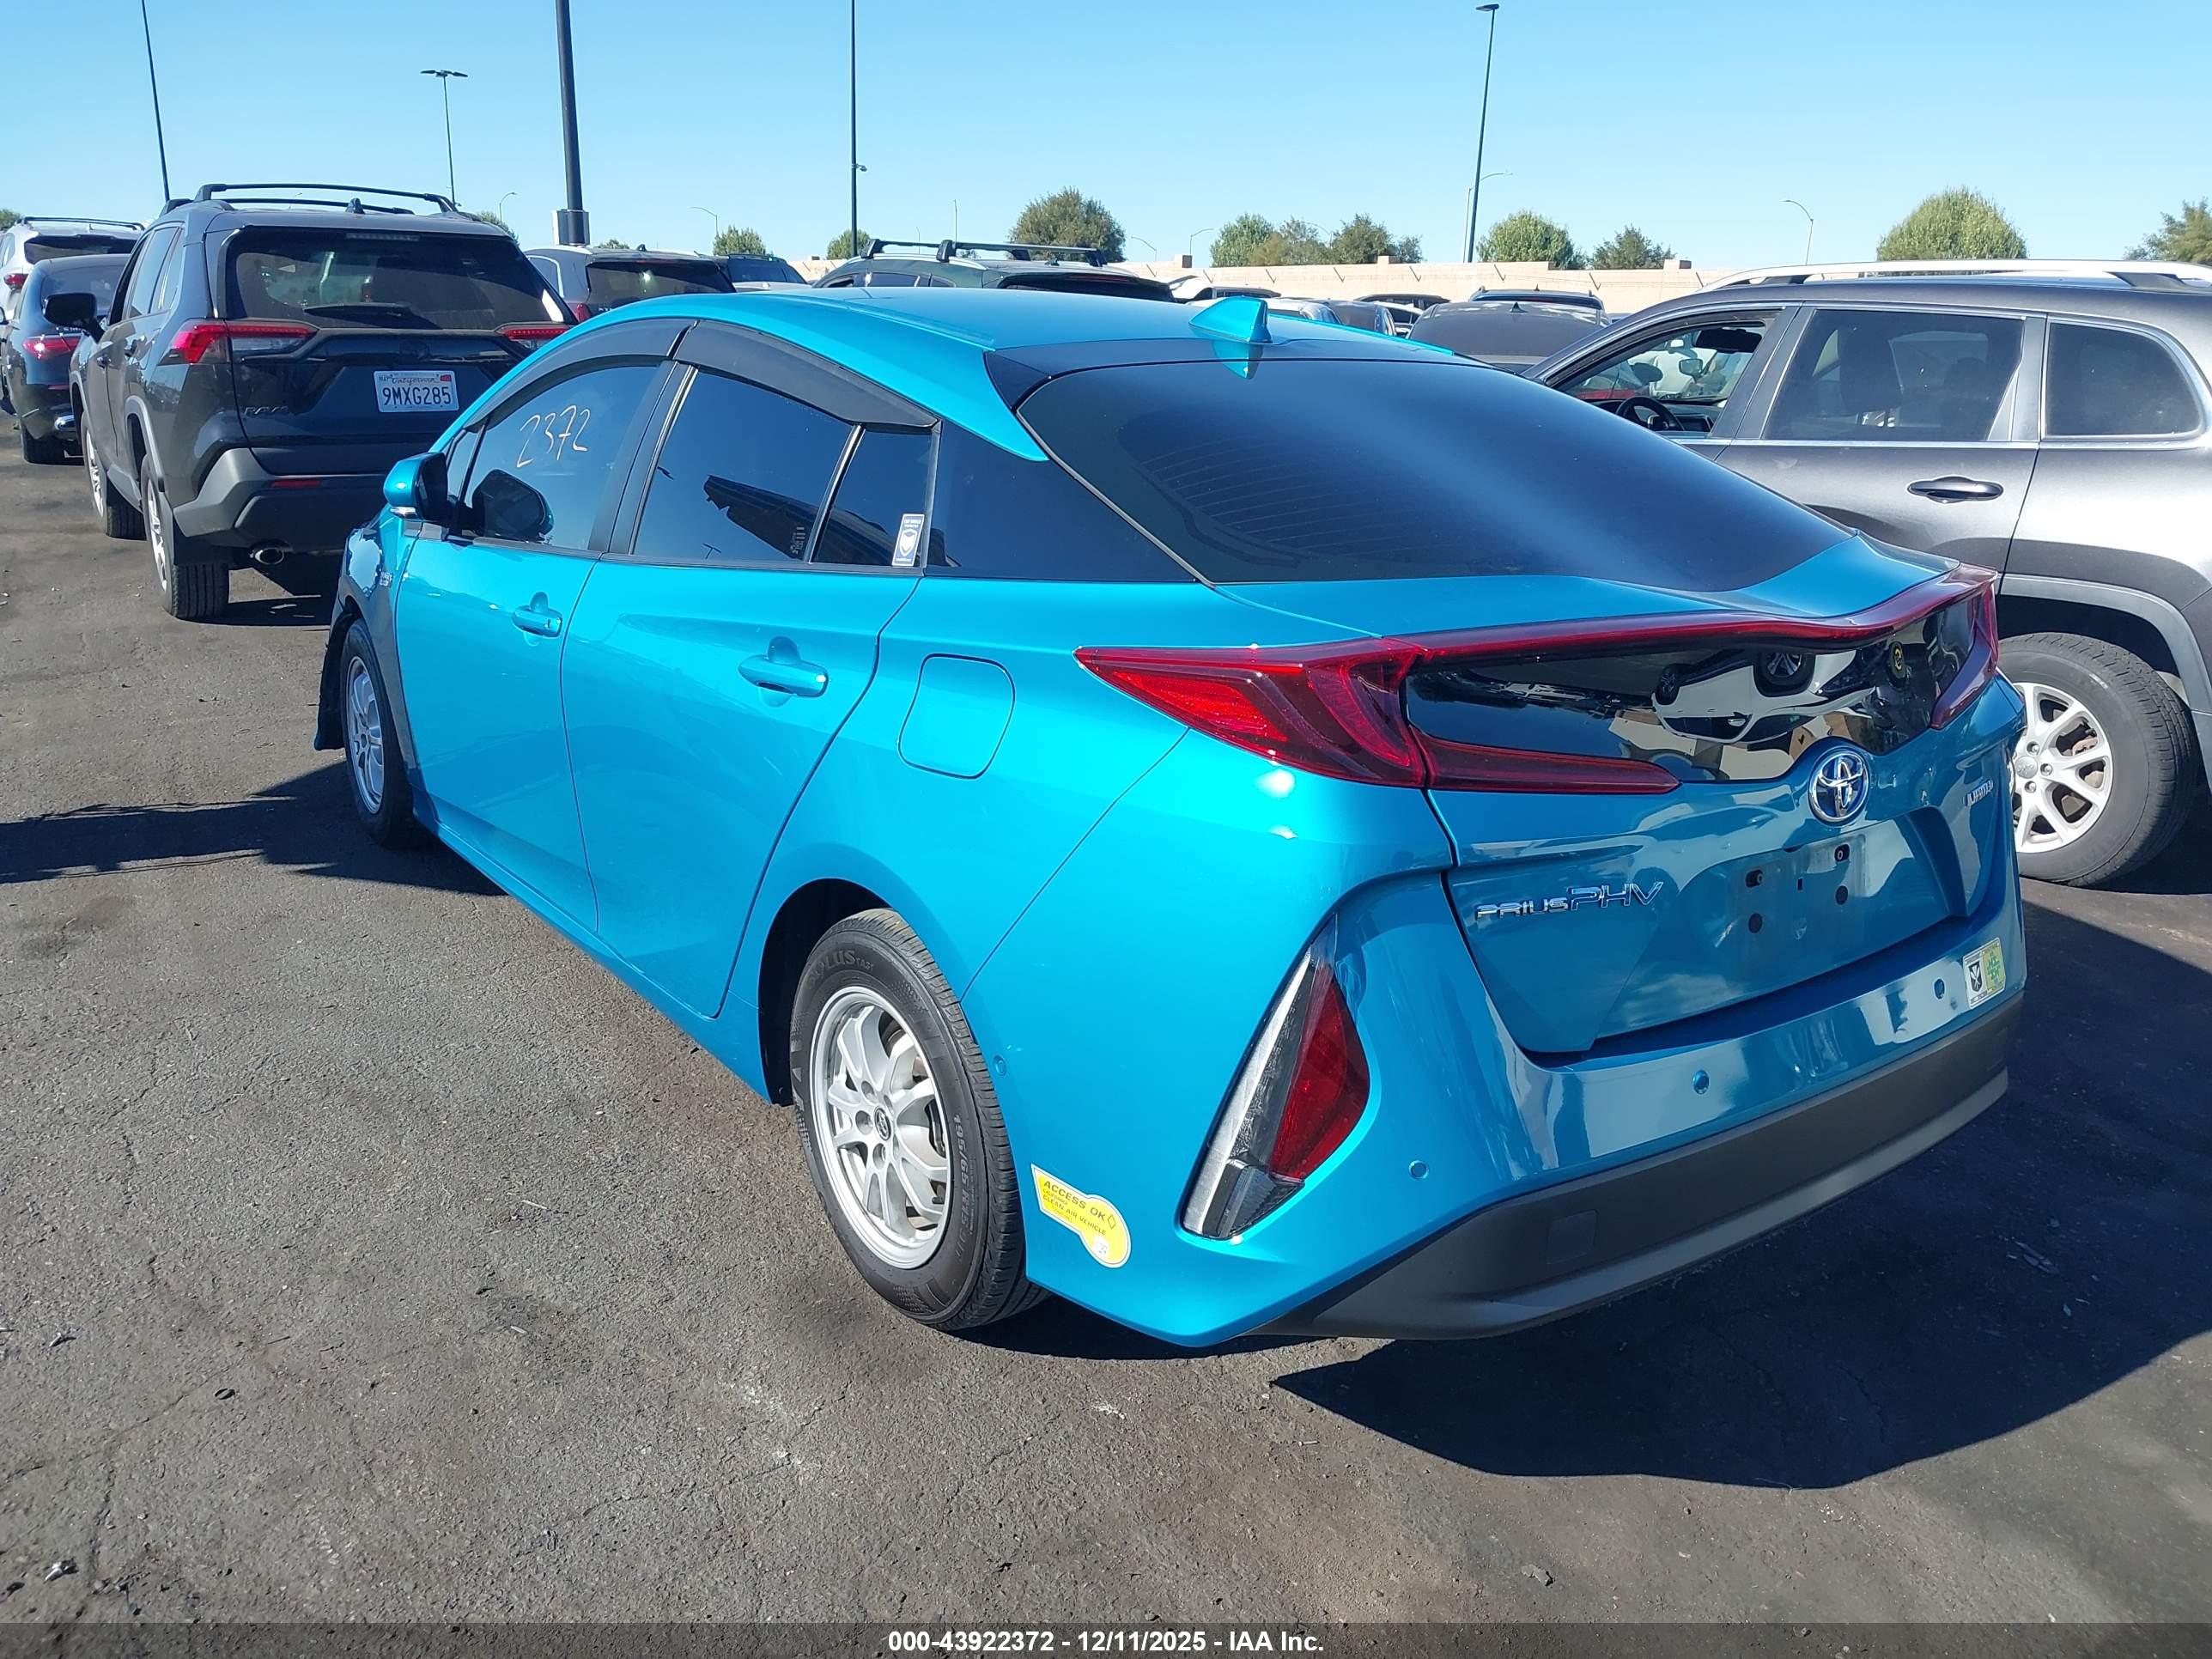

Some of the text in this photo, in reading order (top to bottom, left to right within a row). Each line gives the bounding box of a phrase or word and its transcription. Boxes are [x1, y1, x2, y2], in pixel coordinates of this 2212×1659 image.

[382, 386, 452, 406] 9MXG285
[516, 404, 591, 468] 2372
[1476, 881, 1664, 919] PRIUS PHV
[1042, 1194, 1065, 1210] CLEAN
[1066, 1208, 1078, 1218] AIR
[1079, 1216, 1107, 1236] VEHICLE
[1043, 1181, 1087, 1209] ACCESS
[1090, 1206, 1106, 1222] OK
